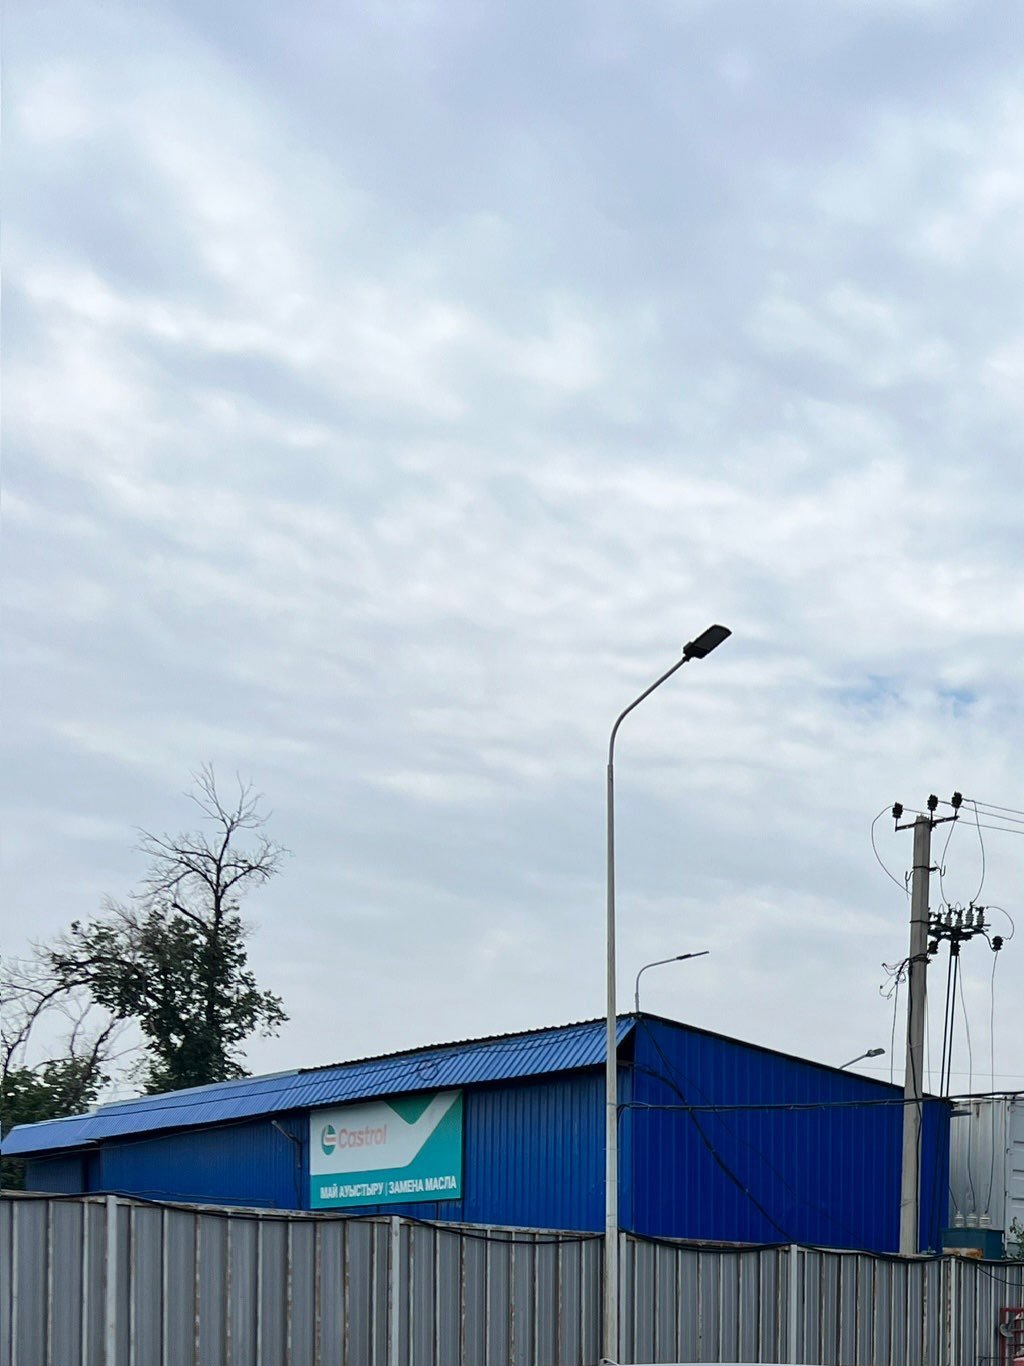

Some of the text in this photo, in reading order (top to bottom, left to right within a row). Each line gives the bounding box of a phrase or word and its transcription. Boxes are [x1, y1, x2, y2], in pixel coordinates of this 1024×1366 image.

[338, 1124, 387, 1149] Castrol
[389, 1179, 424, 1194] ЗАМЕНА
[425, 1176, 457, 1191] МАСЛА
